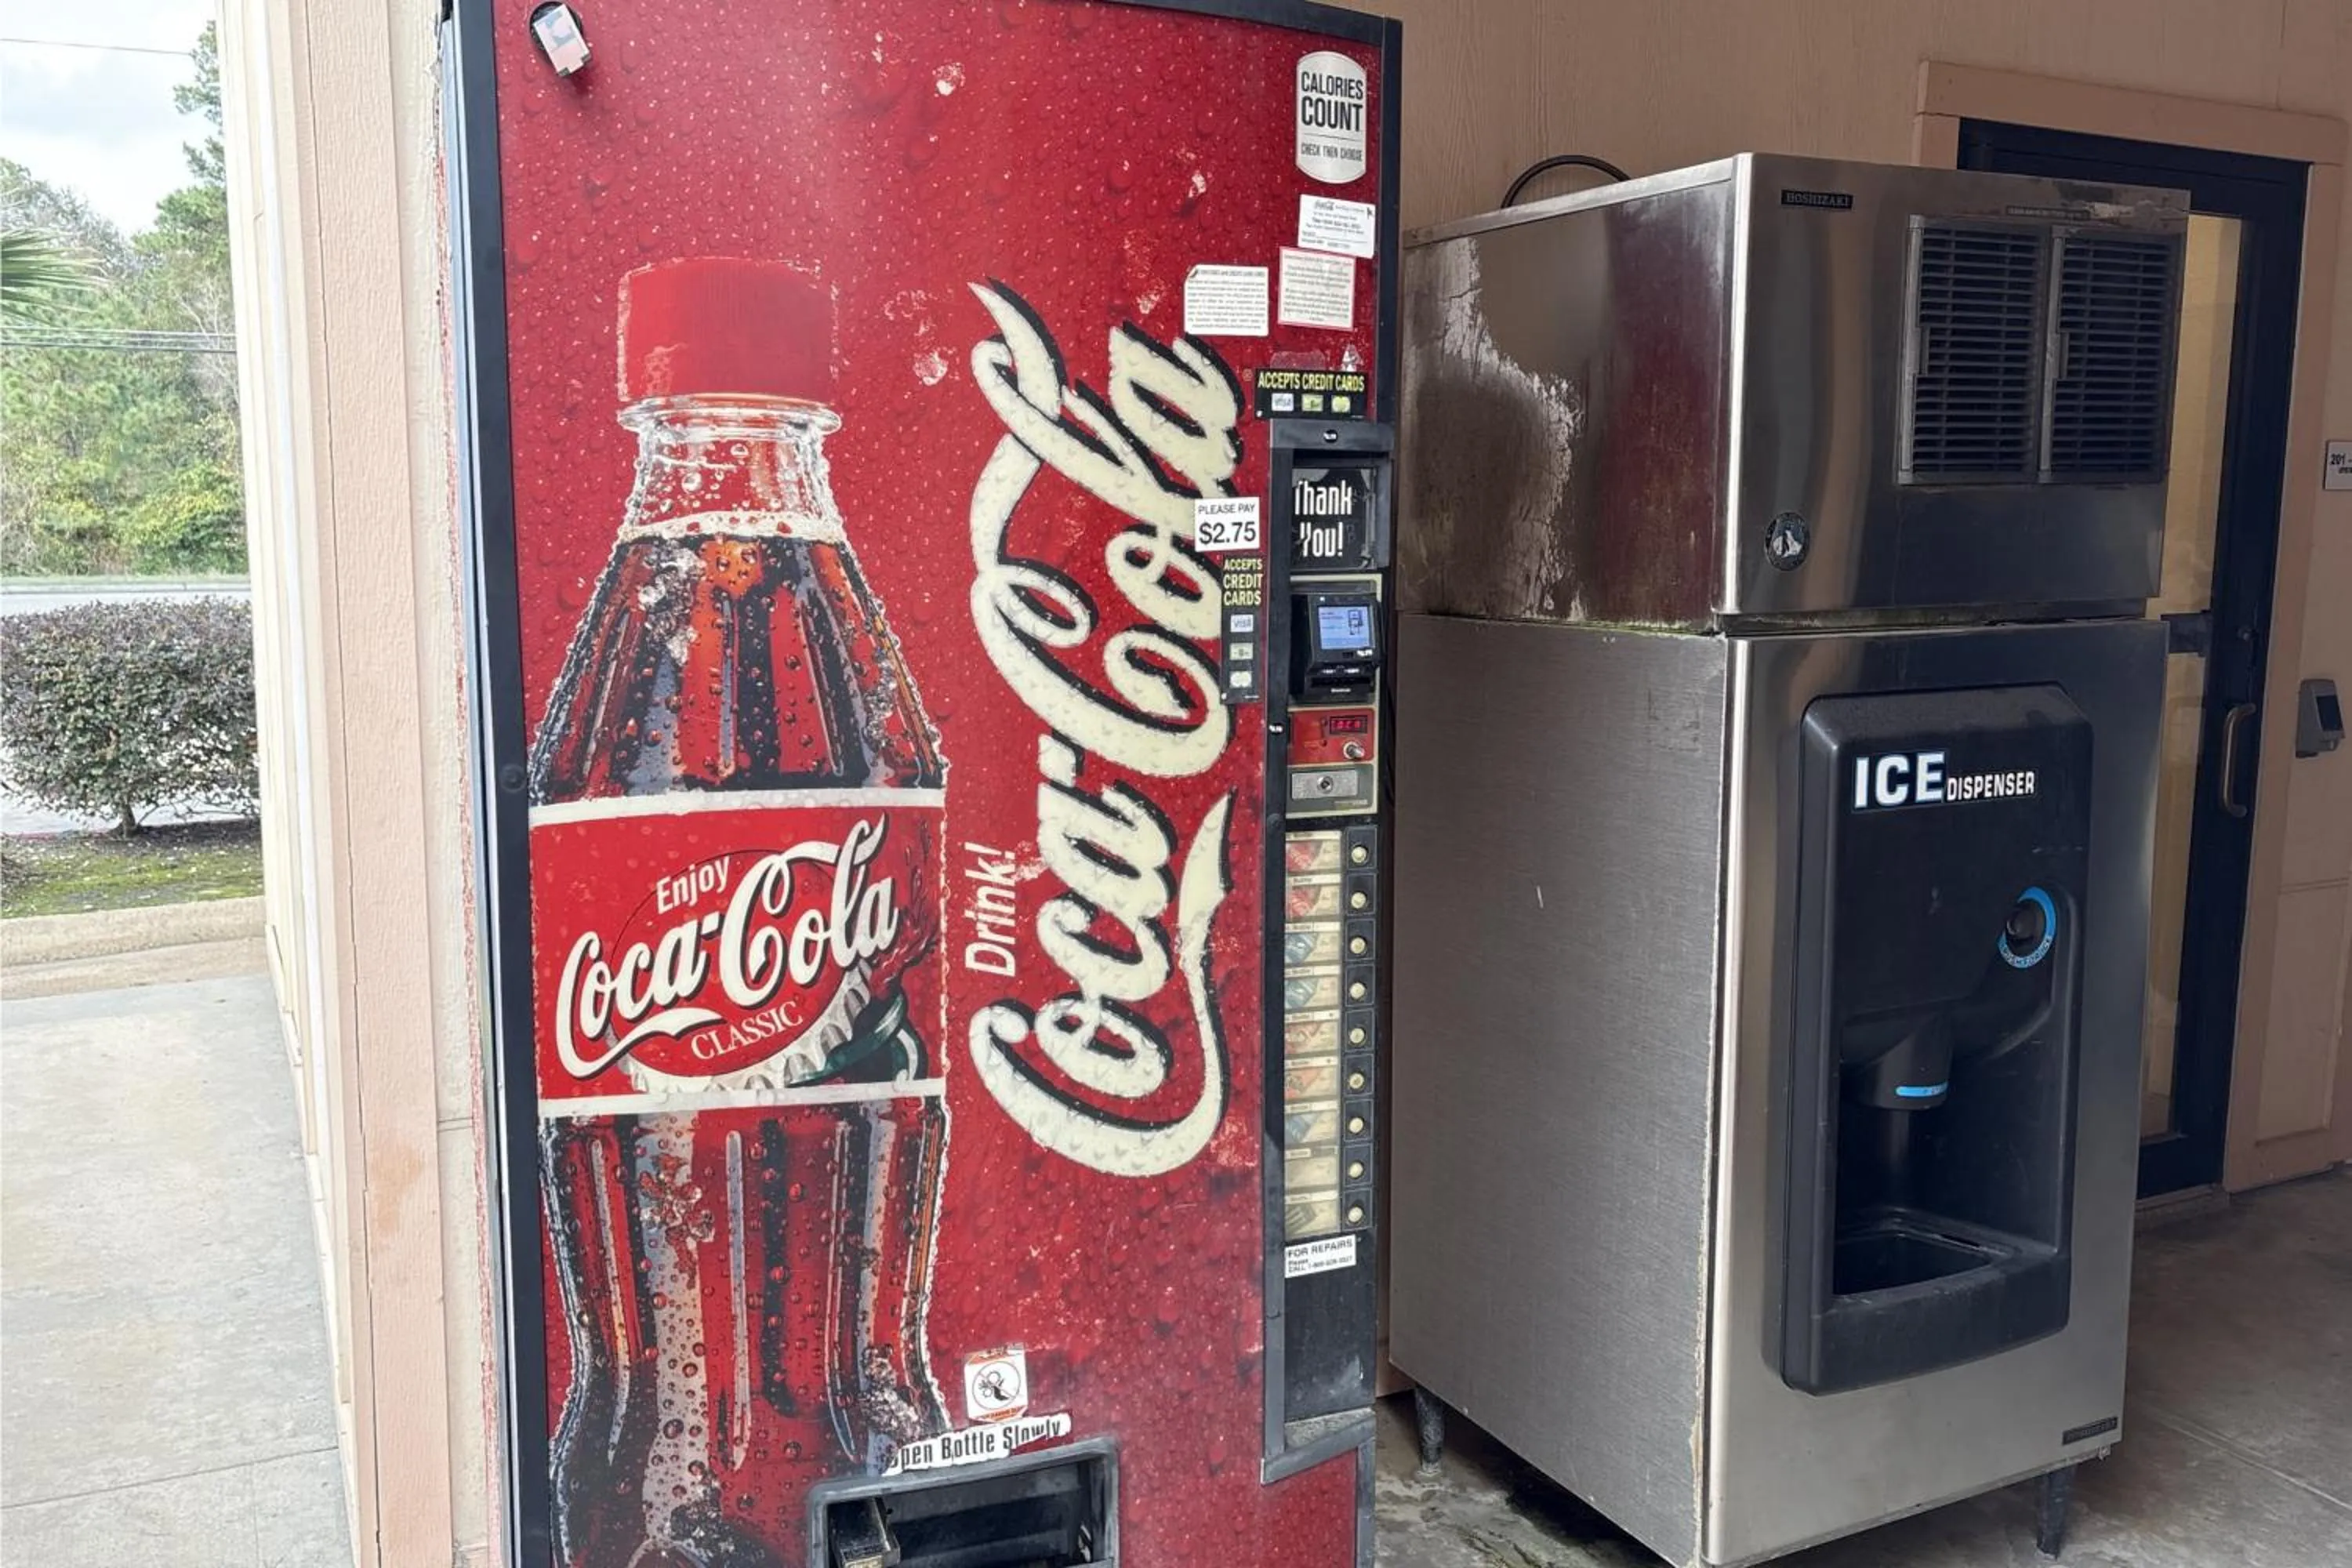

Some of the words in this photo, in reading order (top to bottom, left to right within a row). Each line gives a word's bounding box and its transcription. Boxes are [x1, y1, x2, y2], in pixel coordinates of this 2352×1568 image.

[1301, 71, 1363, 100] CALORIES
[1301, 96, 1363, 132] COUNT
[1301, 143, 1320, 156] CHECK
[1258, 372, 1301, 390] ACCEPTS
[1302, 373, 1334, 390] CREDIT
[1335, 374, 1365, 392] CARDS
[1198, 504, 1236, 515] PLEASE
[1238, 503, 1256, 514] PAY
[1294, 480, 1352, 515] Thank
[1199, 521, 1257, 545] $2.75
[1300, 521, 1344, 557] You!
[1224, 558, 1263, 571] ACCEPTS
[1224, 573, 1263, 590] CREDIT
[1224, 590, 1261, 606] CARDS
[1854, 752, 1945, 808] ICE
[1947, 771, 2035, 801] DISPENSER
[655, 855, 731, 915] Enjoy
[964, 841, 1016, 978] Drink!
[556, 812, 901, 1078] Coca-Cola
[691, 1000, 803, 1060] CLASSIC
[1288, 1247, 1308, 1258] FOR
[1311, 1239, 1352, 1254] REPAIRS
[942, 1431, 995, 1461] Bottle
